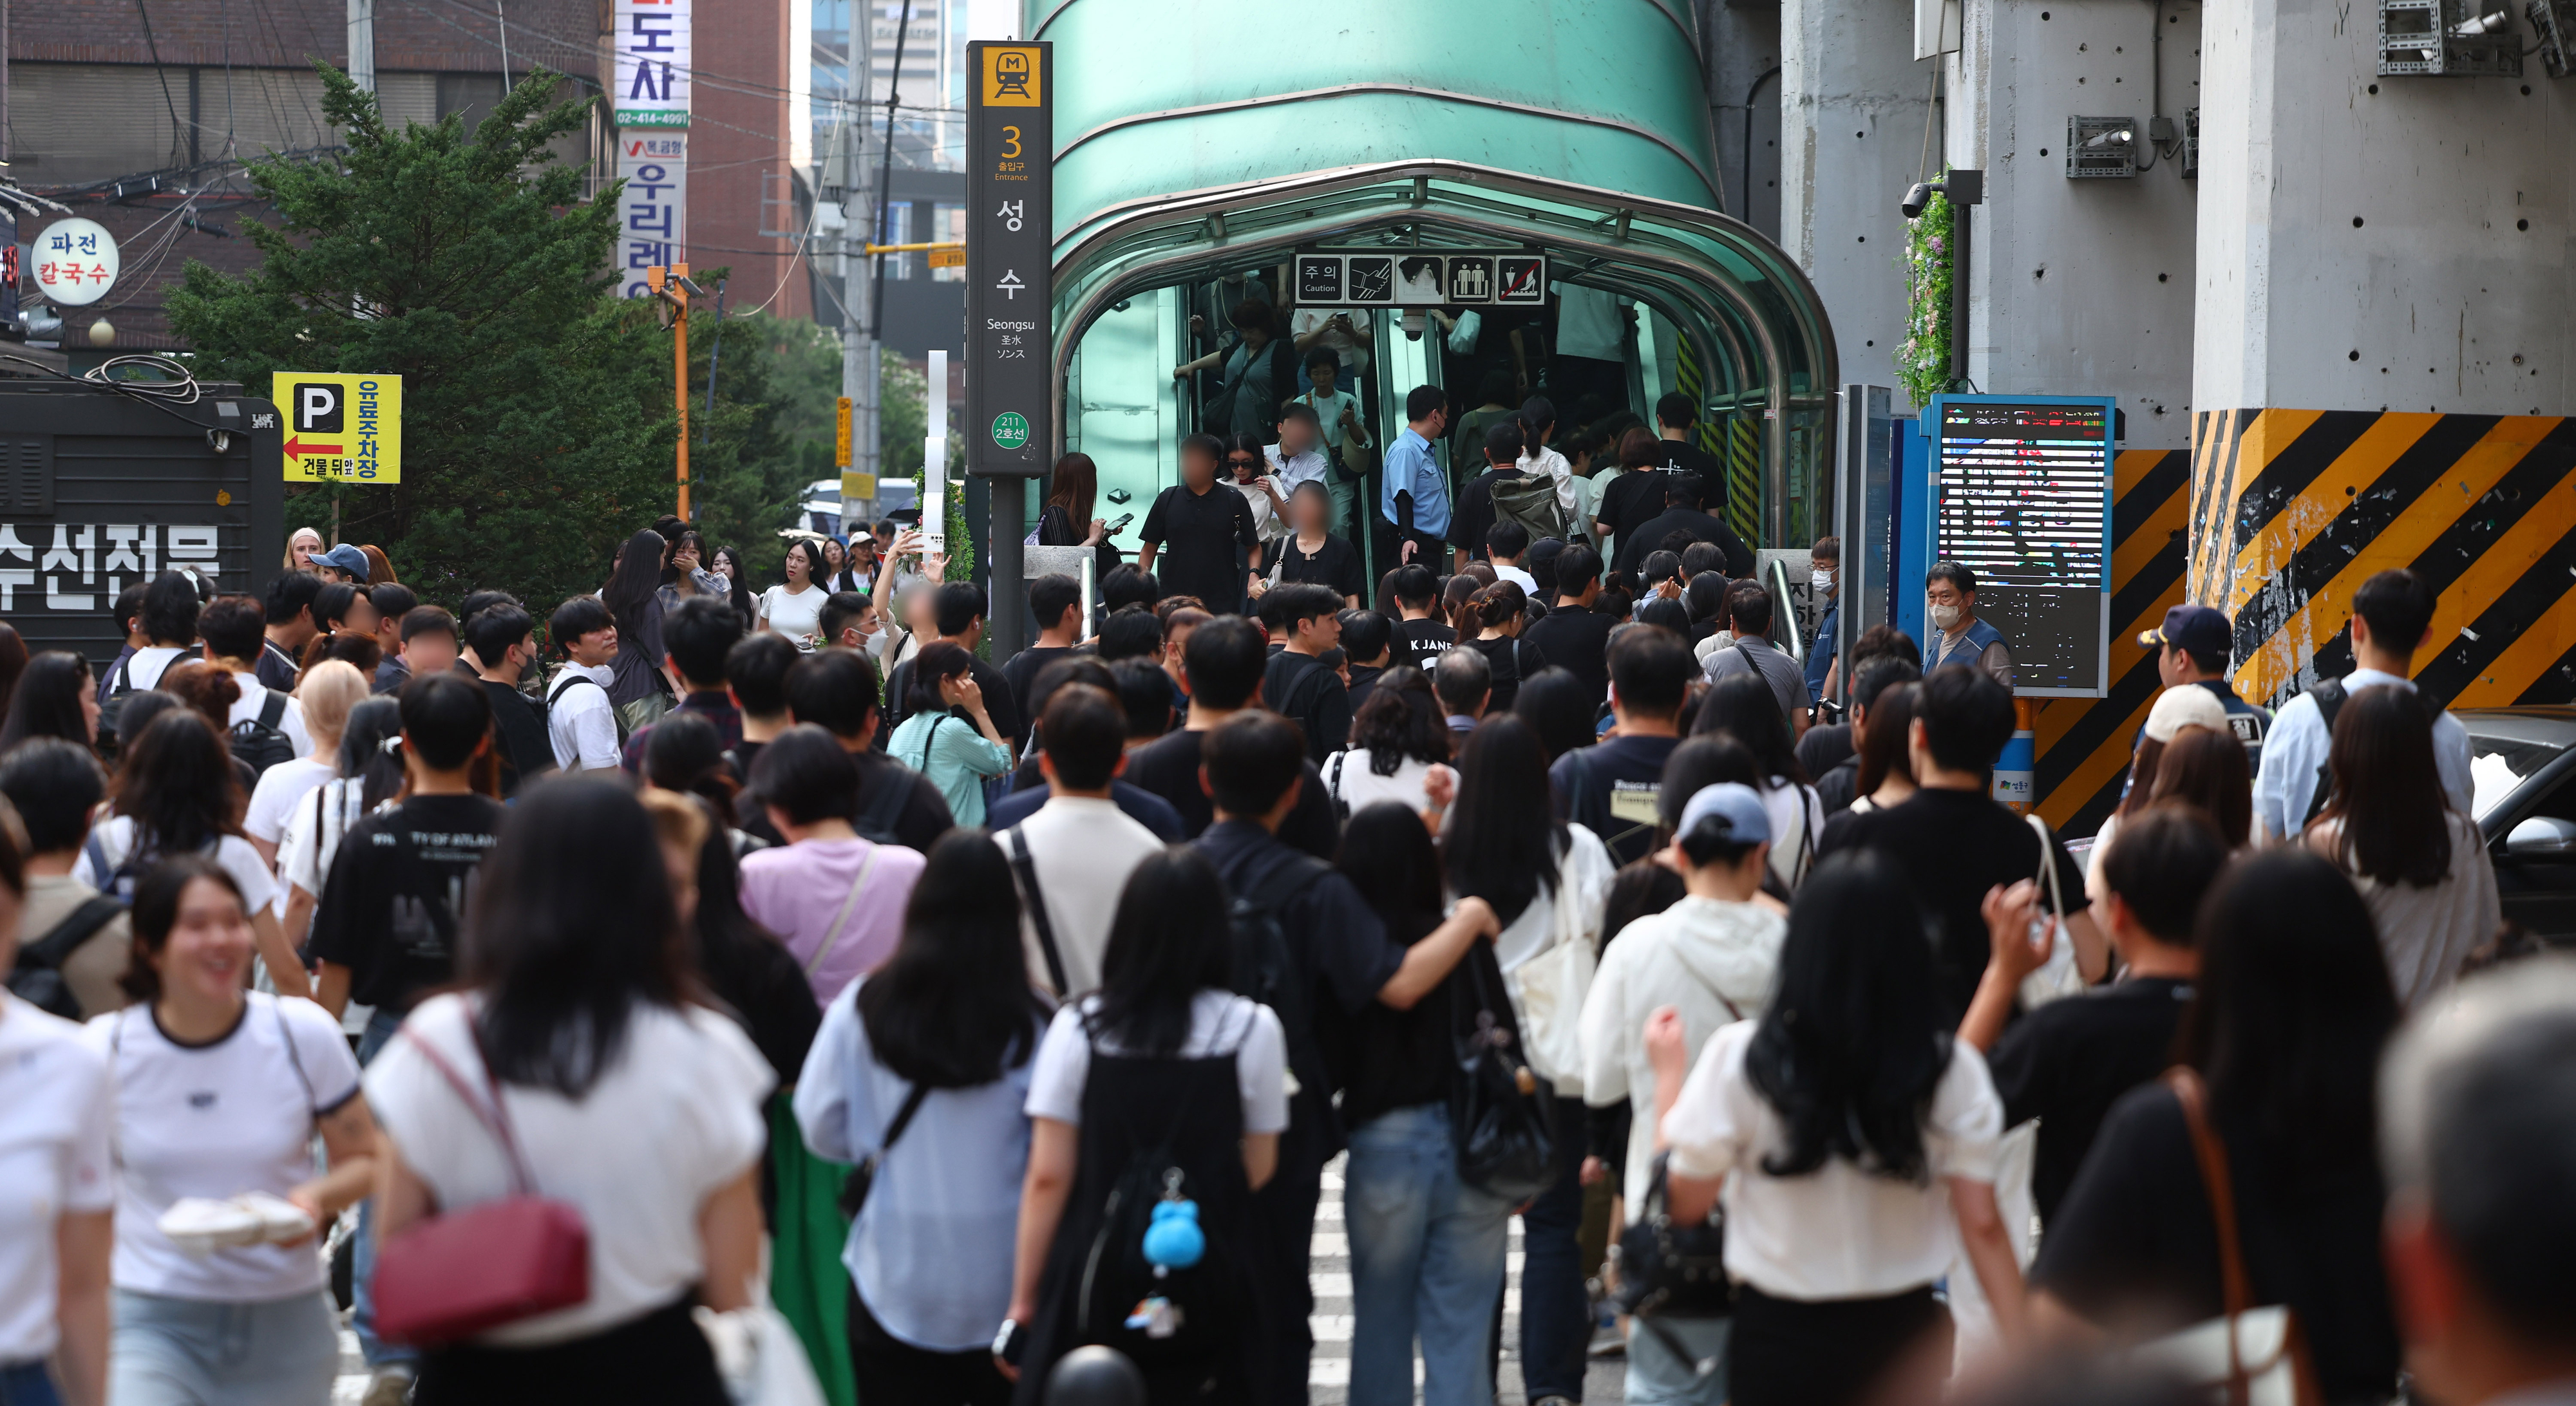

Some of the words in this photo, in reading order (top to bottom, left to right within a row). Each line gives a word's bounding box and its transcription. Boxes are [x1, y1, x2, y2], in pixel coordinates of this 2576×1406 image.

[618, 112, 687, 125] 02-414-4991
[1001, 125, 1022, 159] 3
[998, 162, 1025, 172] 출입구
[628, 164, 675, 299] 우리레
[51, 232, 98, 256] 파전
[39, 261, 110, 285] 칼국수
[987, 318, 1035, 332] Seongsu
[1001, 335, 1022, 346] 圣水
[997, 350, 1025, 359] ソンス
[303, 387, 335, 429] P
[1001, 417, 1018, 426] 211
[357, 380, 379, 479] 유료주차장
[996, 428, 1024, 440] 2호선
[304, 458, 327, 476] 건물
[2012, 781, 2029, 791] 성동구
[451, 832, 498, 848] ATLAN
